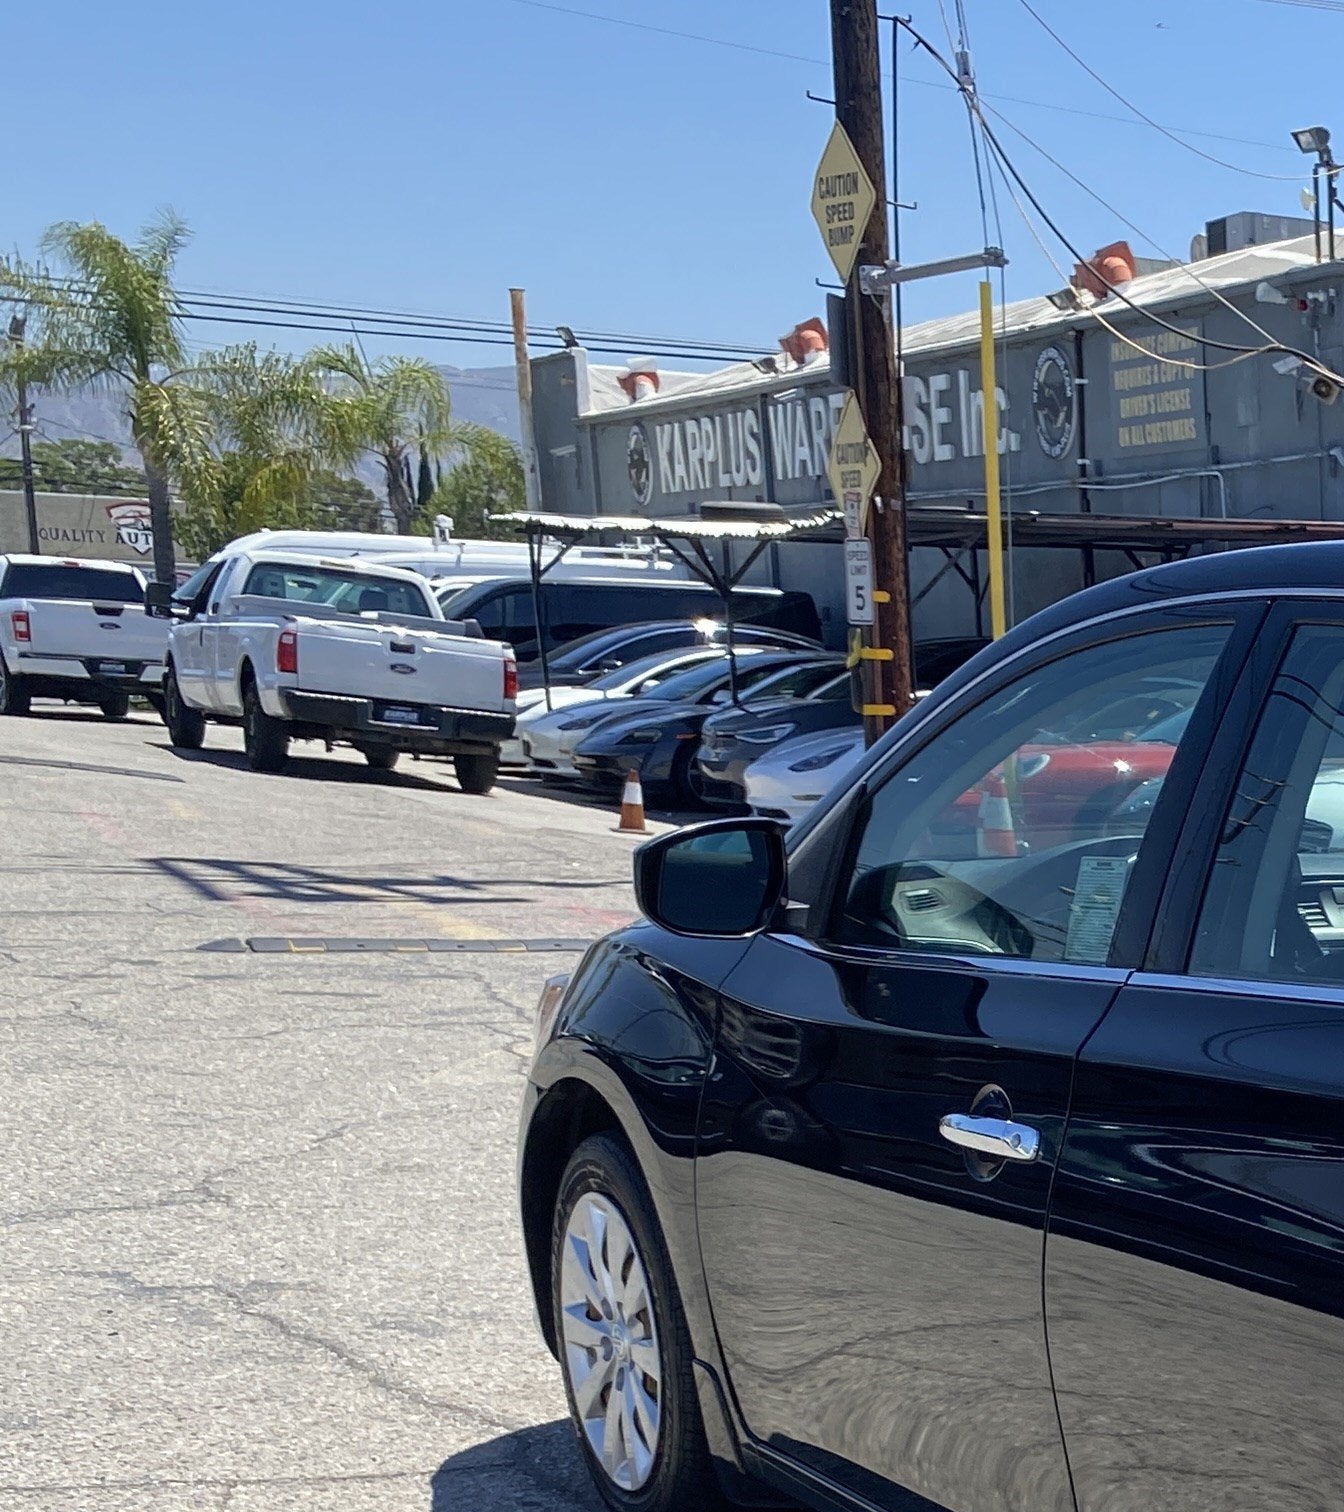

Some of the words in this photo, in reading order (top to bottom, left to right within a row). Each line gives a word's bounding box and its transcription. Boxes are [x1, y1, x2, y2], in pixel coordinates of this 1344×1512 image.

[818, 171, 859, 199] CAUTION
[826, 202, 855, 224] SPEED
[828, 225, 855, 247] BUMP
[655, 408, 764, 493] KARPLUS
[39, 527, 105, 543] QUALITY
[115, 532, 151, 545] AUT
[847, 551, 868, 561] SPEED
[855, 586, 866, 611] 5
